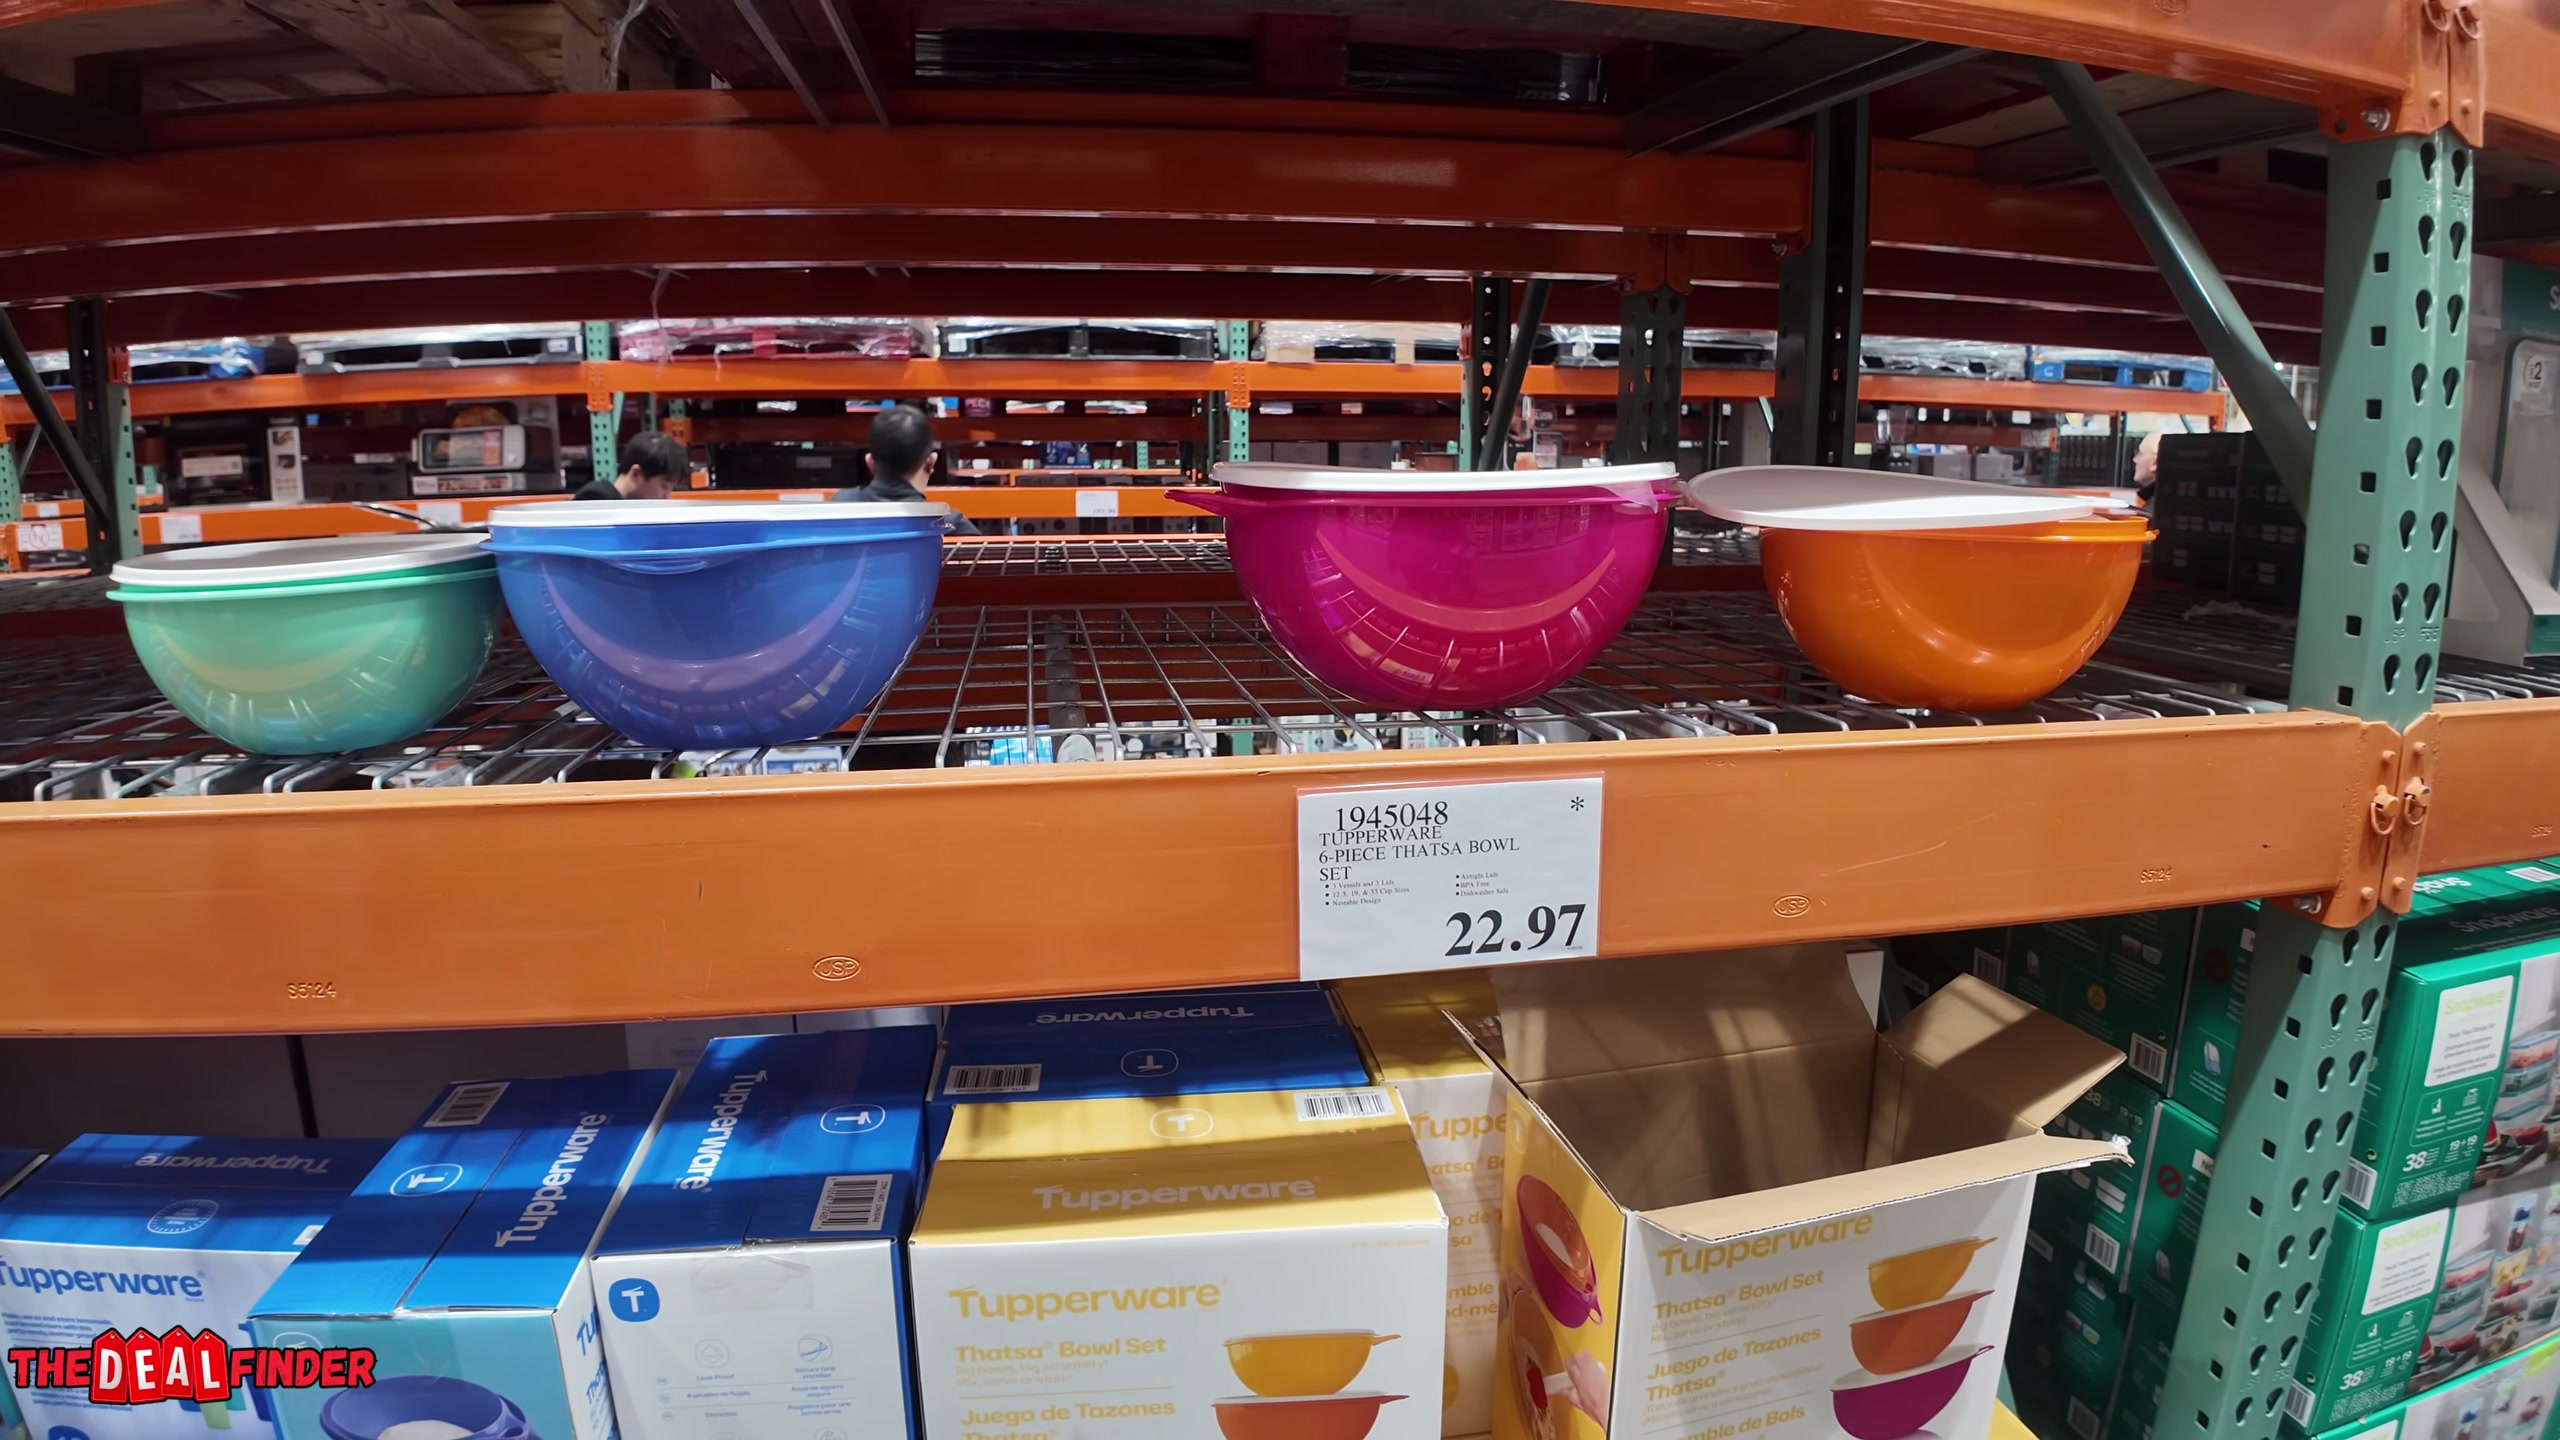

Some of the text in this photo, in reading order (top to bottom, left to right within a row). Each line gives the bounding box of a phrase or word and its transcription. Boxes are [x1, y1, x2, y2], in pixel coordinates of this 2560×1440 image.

[1336, 801, 1448, 831] 1945048
[1319, 826, 1442, 846] TUPPERWARE
[1319, 837, 1520, 864] 6-PIECE THATSA BOWL
[1320, 866, 1352, 881] SET
[1360, 898, 1381, 906] Design
[1461, 889, 1494, 897] Dishwasher
[1445, 904, 1586, 956] 22.97
[1036, 1007, 1254, 1024] Tupperware
[680, 1070, 769, 1190] Tupperware
[134, 1153, 331, 1175] Tupperware
[2402, 1151, 2427, 1172] 38
[494, 1113, 607, 1248] Tupperware
[1032, 1179, 1315, 1211] Tupperware
[1657, 1214, 1873, 1276] Tupperware
[1739, 1278, 1790, 1301] Bowl
[1792, 1269, 1825, 1289] Set
[948, 1283, 1221, 1322] Tupperware
[1059, 1339, 1120, 1357] Bowl
[1125, 1337, 1167, 1354] Set
[1648, 1328, 1822, 1379] Juego de Tazones
[2339, 1369, 2364, 1391] 38
[960, 1401, 1176, 1427] Juego de Tazones
[1739, 1416, 1762, 1433] de
[1766, 1405, 1805, 1425] Bols
